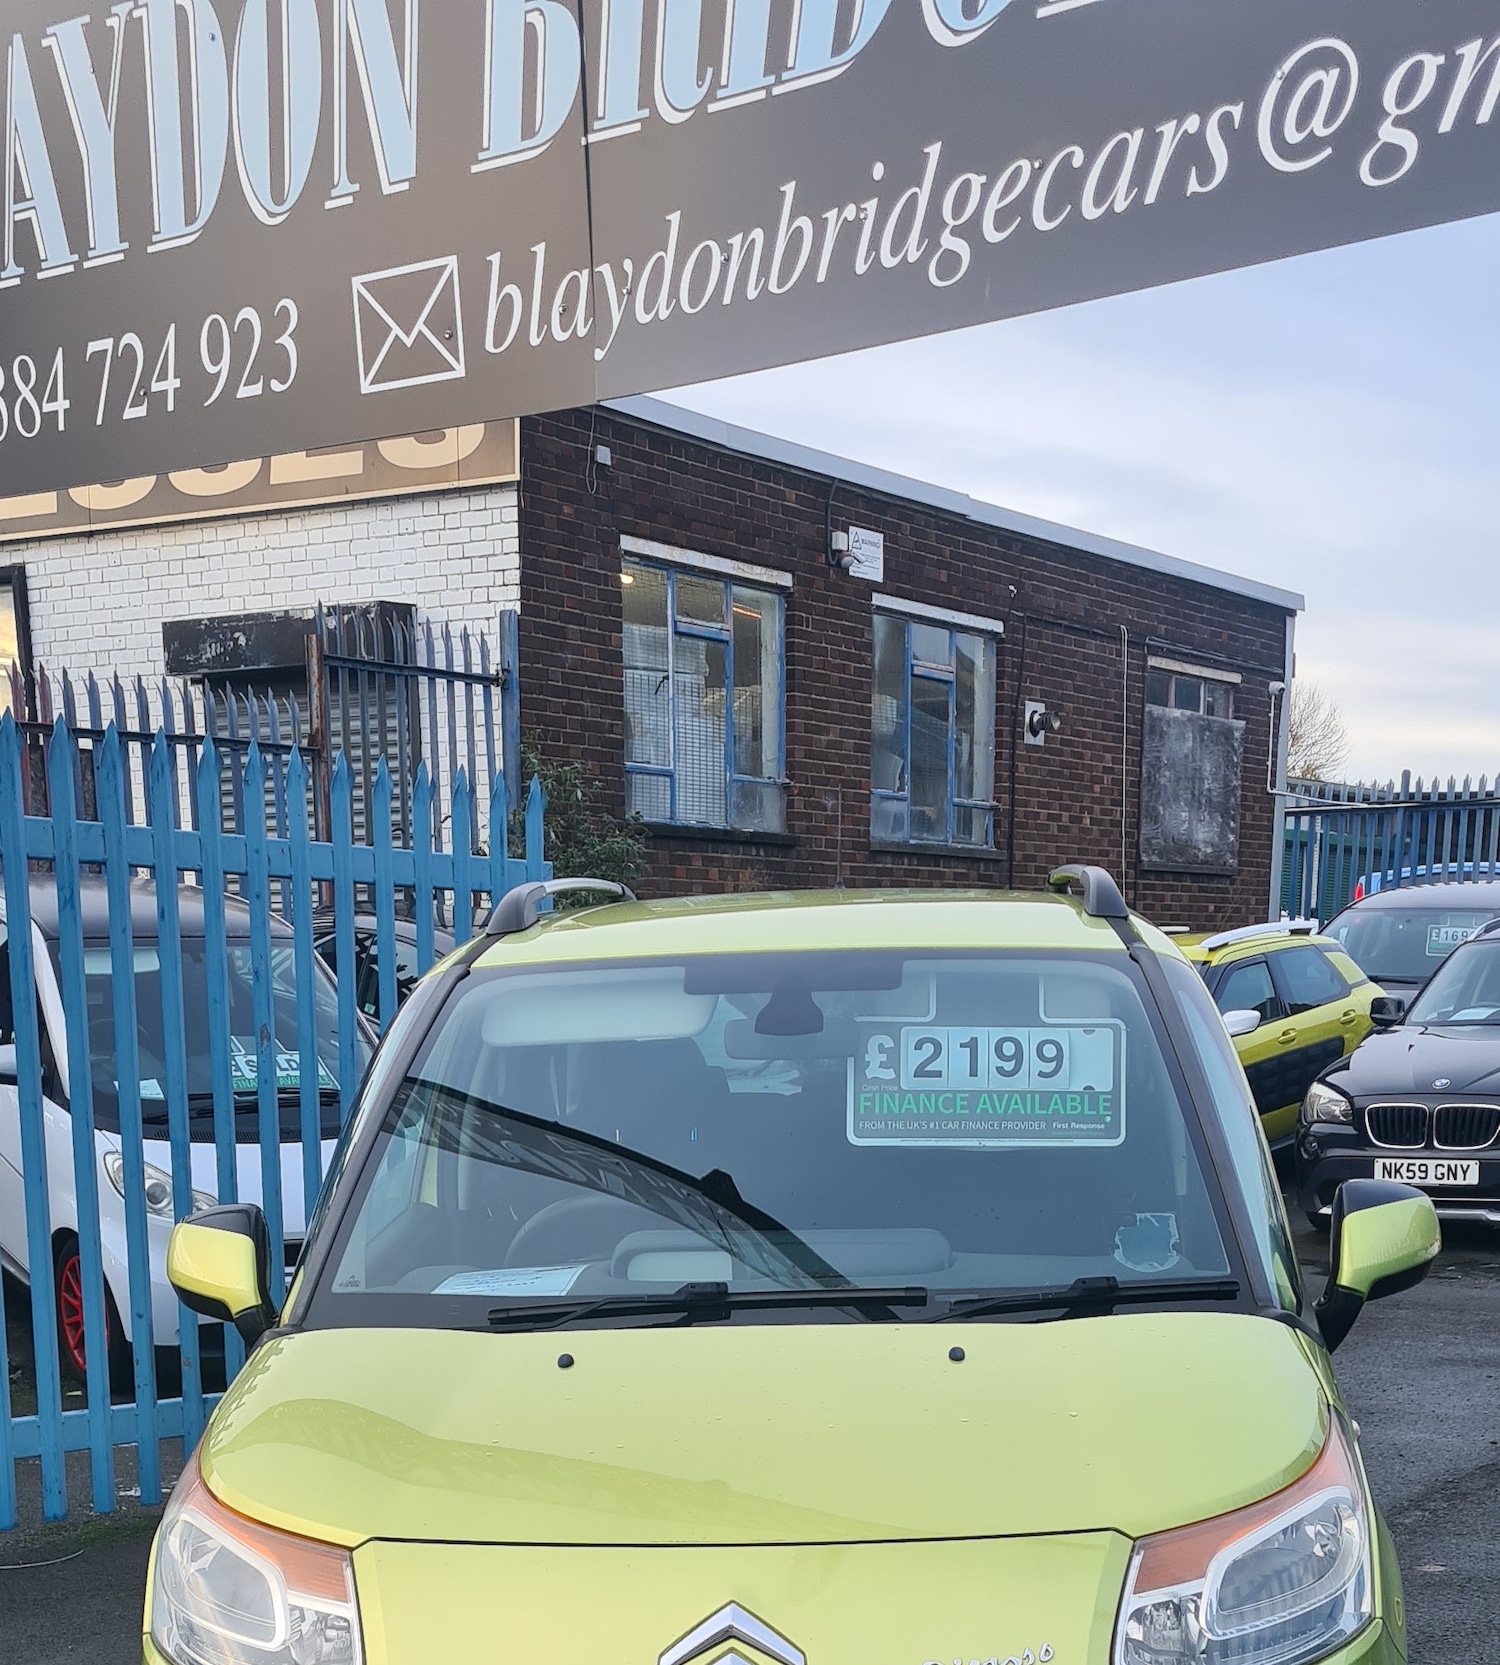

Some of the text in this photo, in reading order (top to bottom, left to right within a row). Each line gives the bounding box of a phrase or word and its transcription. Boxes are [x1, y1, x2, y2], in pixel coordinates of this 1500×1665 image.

[0, 346, 70, 443] 84
[86, 322, 181, 426] 724
[200, 298, 299, 407] 923
[859, 1092, 1112, 1115] FINANCE AVAILABLE
[859, 1121, 885, 1130] FROM
[887, 1121, 904, 1130] THE
[906, 1121, 928, 1130] UK'S
[941, 1121, 960, 1130] CAR
[961, 1121, 1000, 1130] FINANCE
[1001, 1121, 1047, 1130] PROVIDER
[1052, 1121, 1106, 1131] First Response
[1382, 1162, 1471, 1181] NK59 GNY
